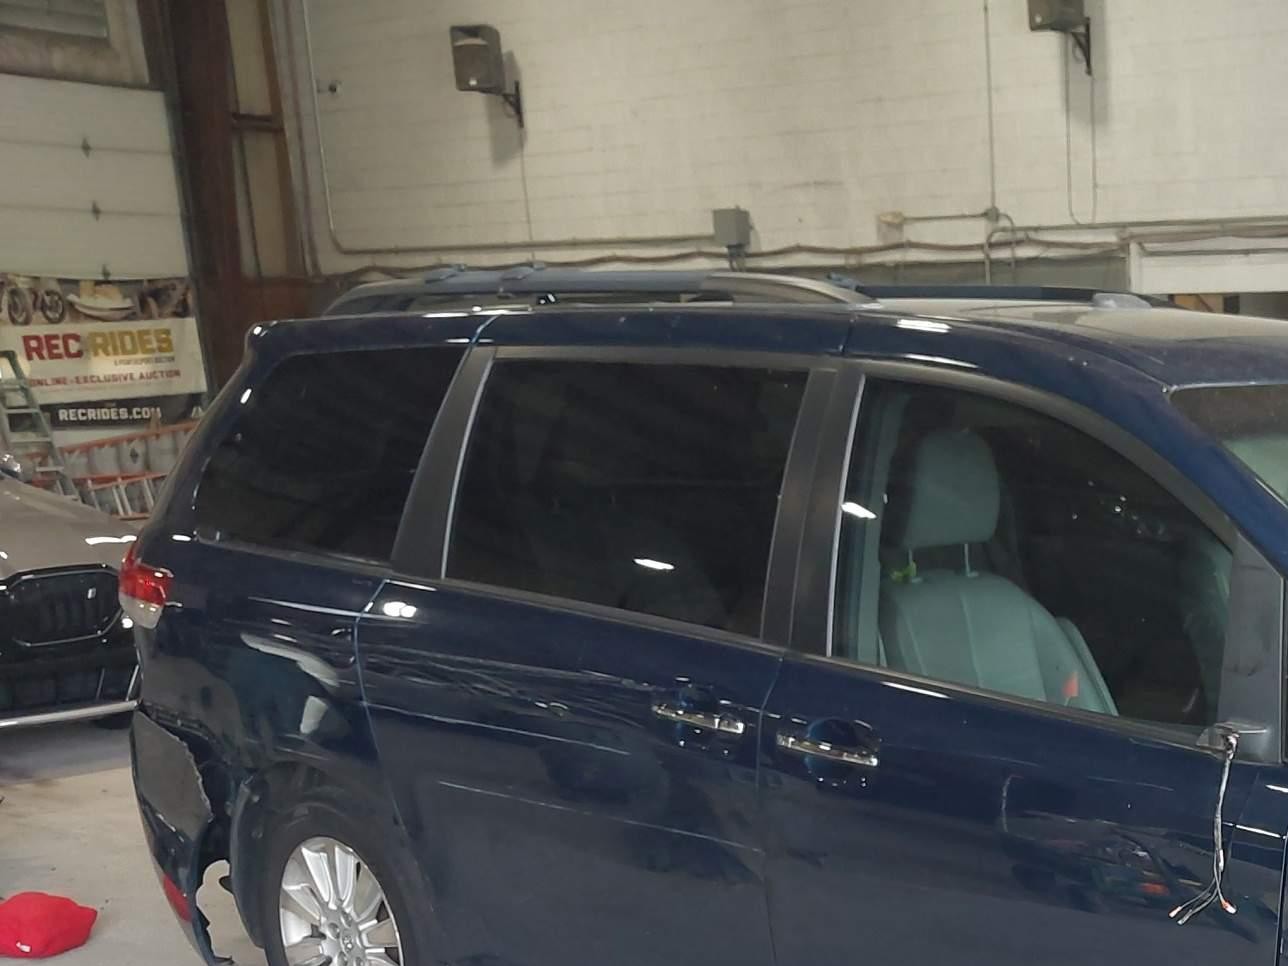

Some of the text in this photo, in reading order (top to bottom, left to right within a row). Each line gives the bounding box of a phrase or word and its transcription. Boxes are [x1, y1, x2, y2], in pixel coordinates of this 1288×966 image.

[22, 328, 174, 361] REC RIDES
[139, 369, 181, 382] AUCTION
